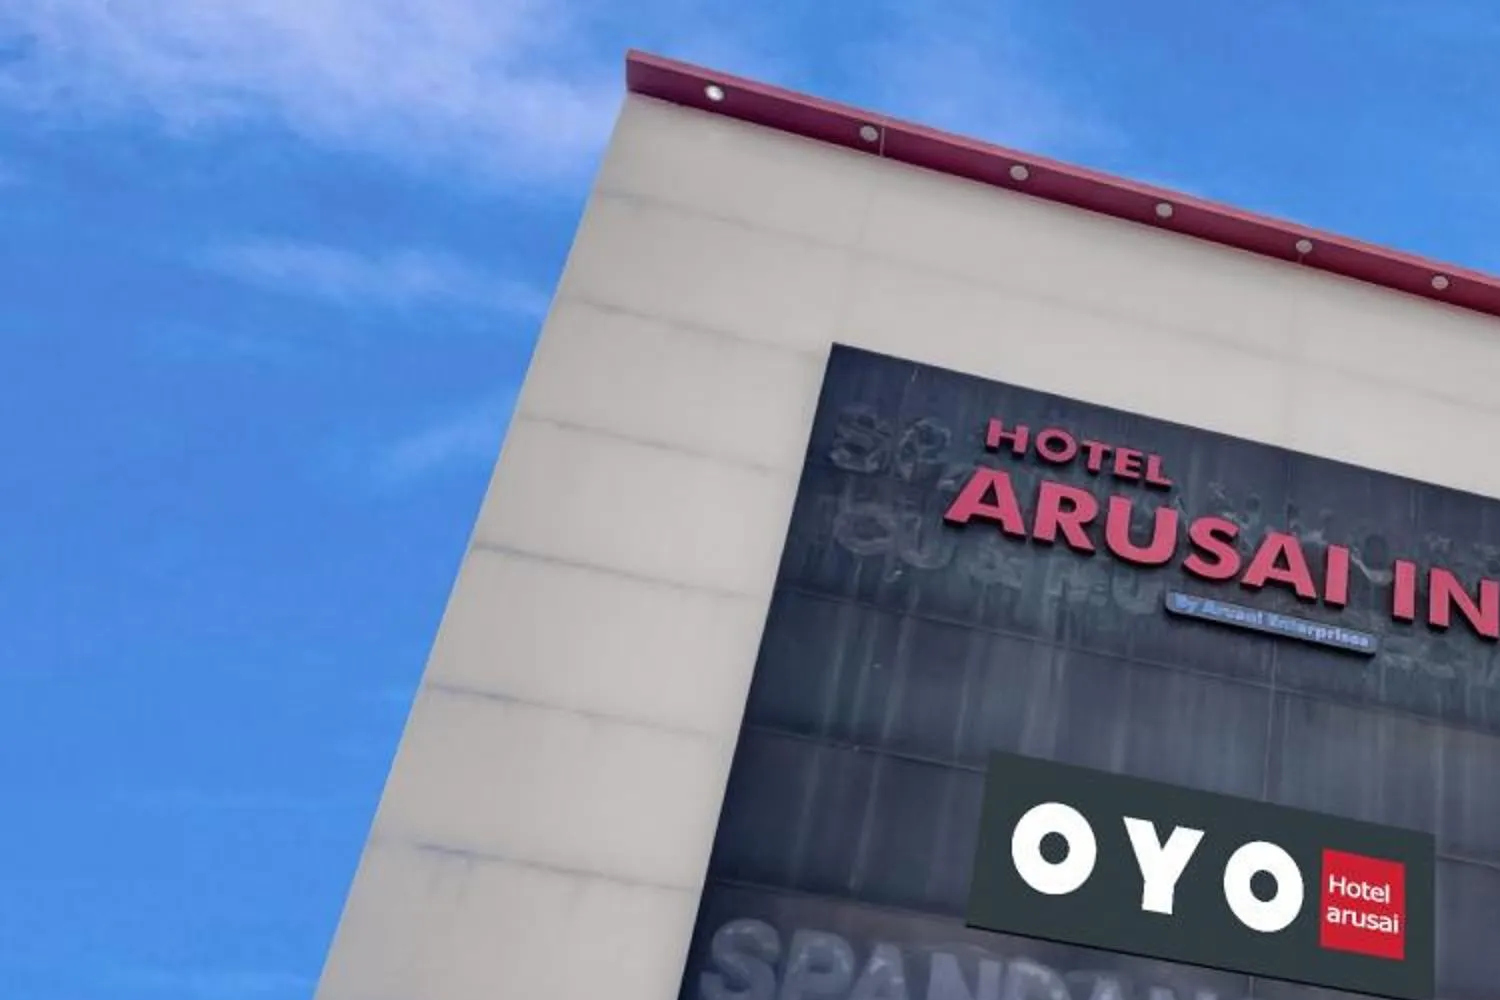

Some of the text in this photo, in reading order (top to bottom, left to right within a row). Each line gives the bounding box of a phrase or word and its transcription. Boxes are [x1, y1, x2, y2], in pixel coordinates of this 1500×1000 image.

[984, 417, 1173, 490] HOTEL
[942, 466, 1350, 609] ARUSAI
[1010, 801, 1305, 935] OYO
[1328, 873, 1391, 905] Hotel
[1326, 906, 1399, 935] arusai
